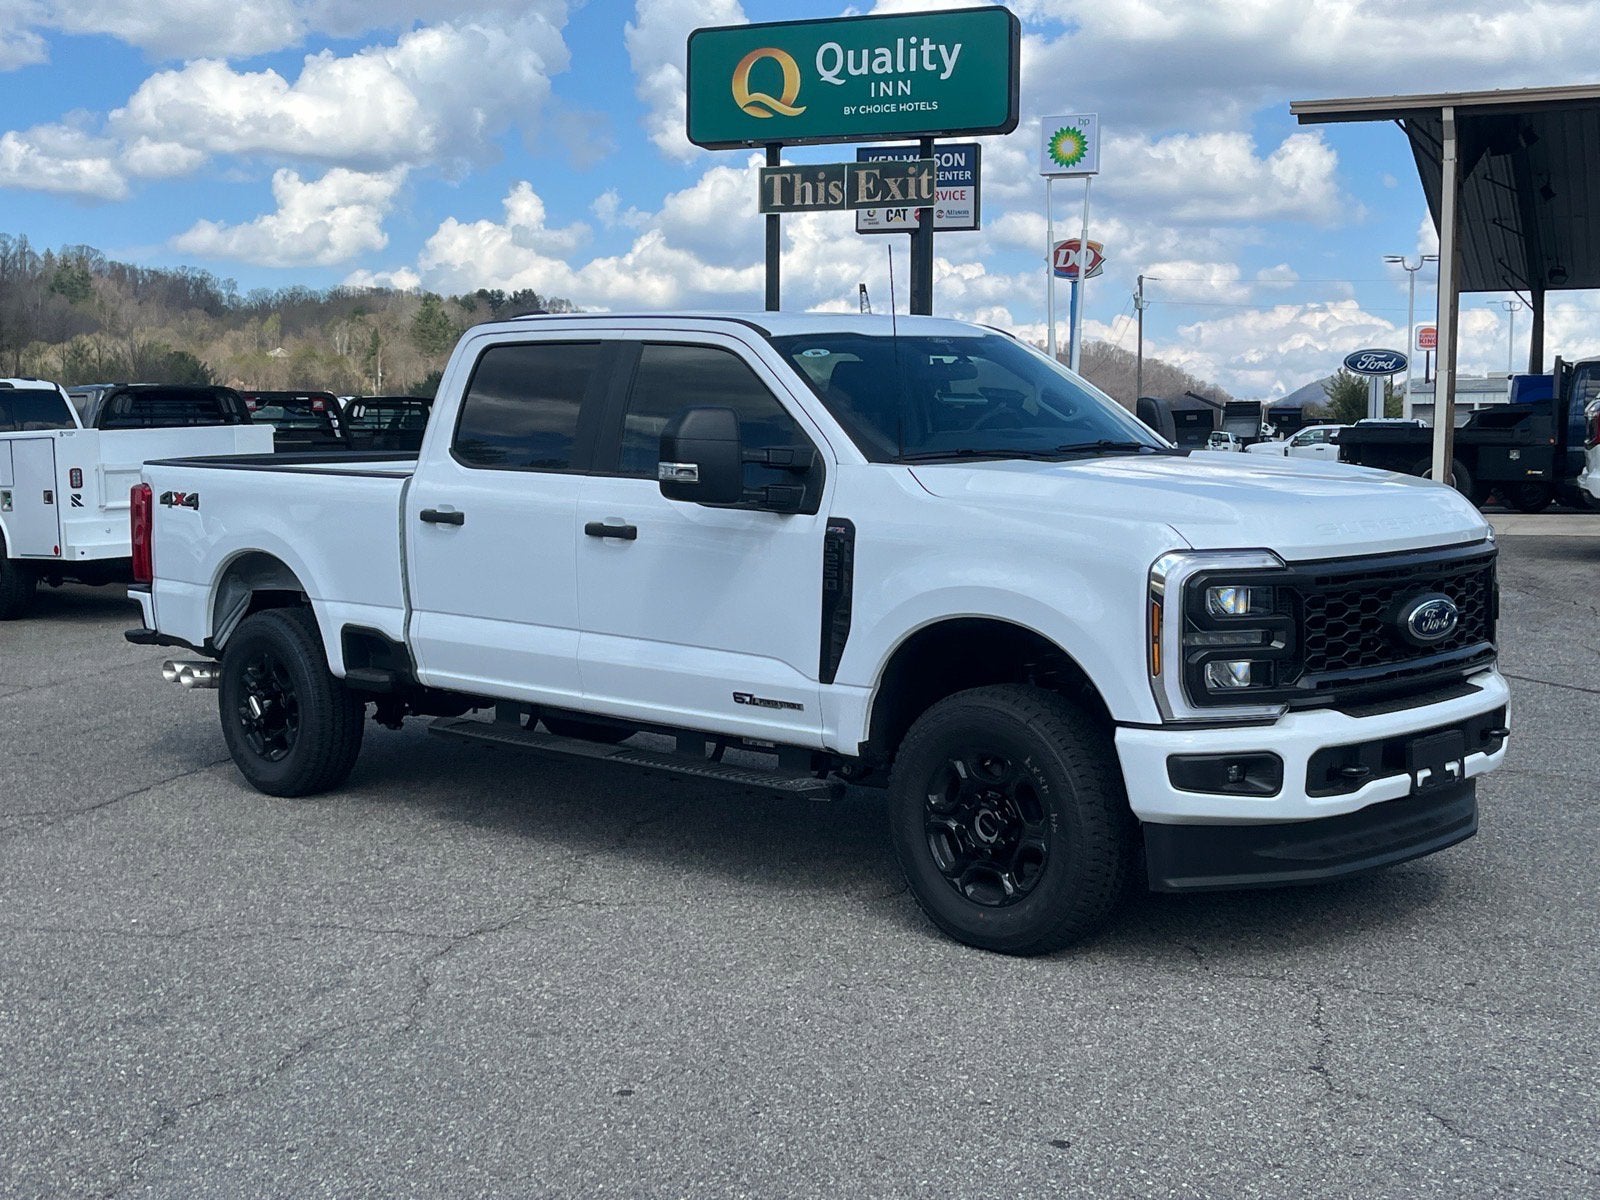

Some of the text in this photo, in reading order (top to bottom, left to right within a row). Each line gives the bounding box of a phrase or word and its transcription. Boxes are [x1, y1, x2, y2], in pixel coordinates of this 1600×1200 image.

[815, 36, 962, 85] Quality
[731, 47, 807, 118] Q
[870, 79, 911, 97] INN
[843, 101, 938, 115] BY CHOICE HOTELS
[1078, 117, 1090, 127] bp
[764, 167, 933, 207] This Exit
[886, 208, 909, 223] CAT
[1356, 353, 1398, 370] Ford
[1421, 608, 1450, 632] Ford
